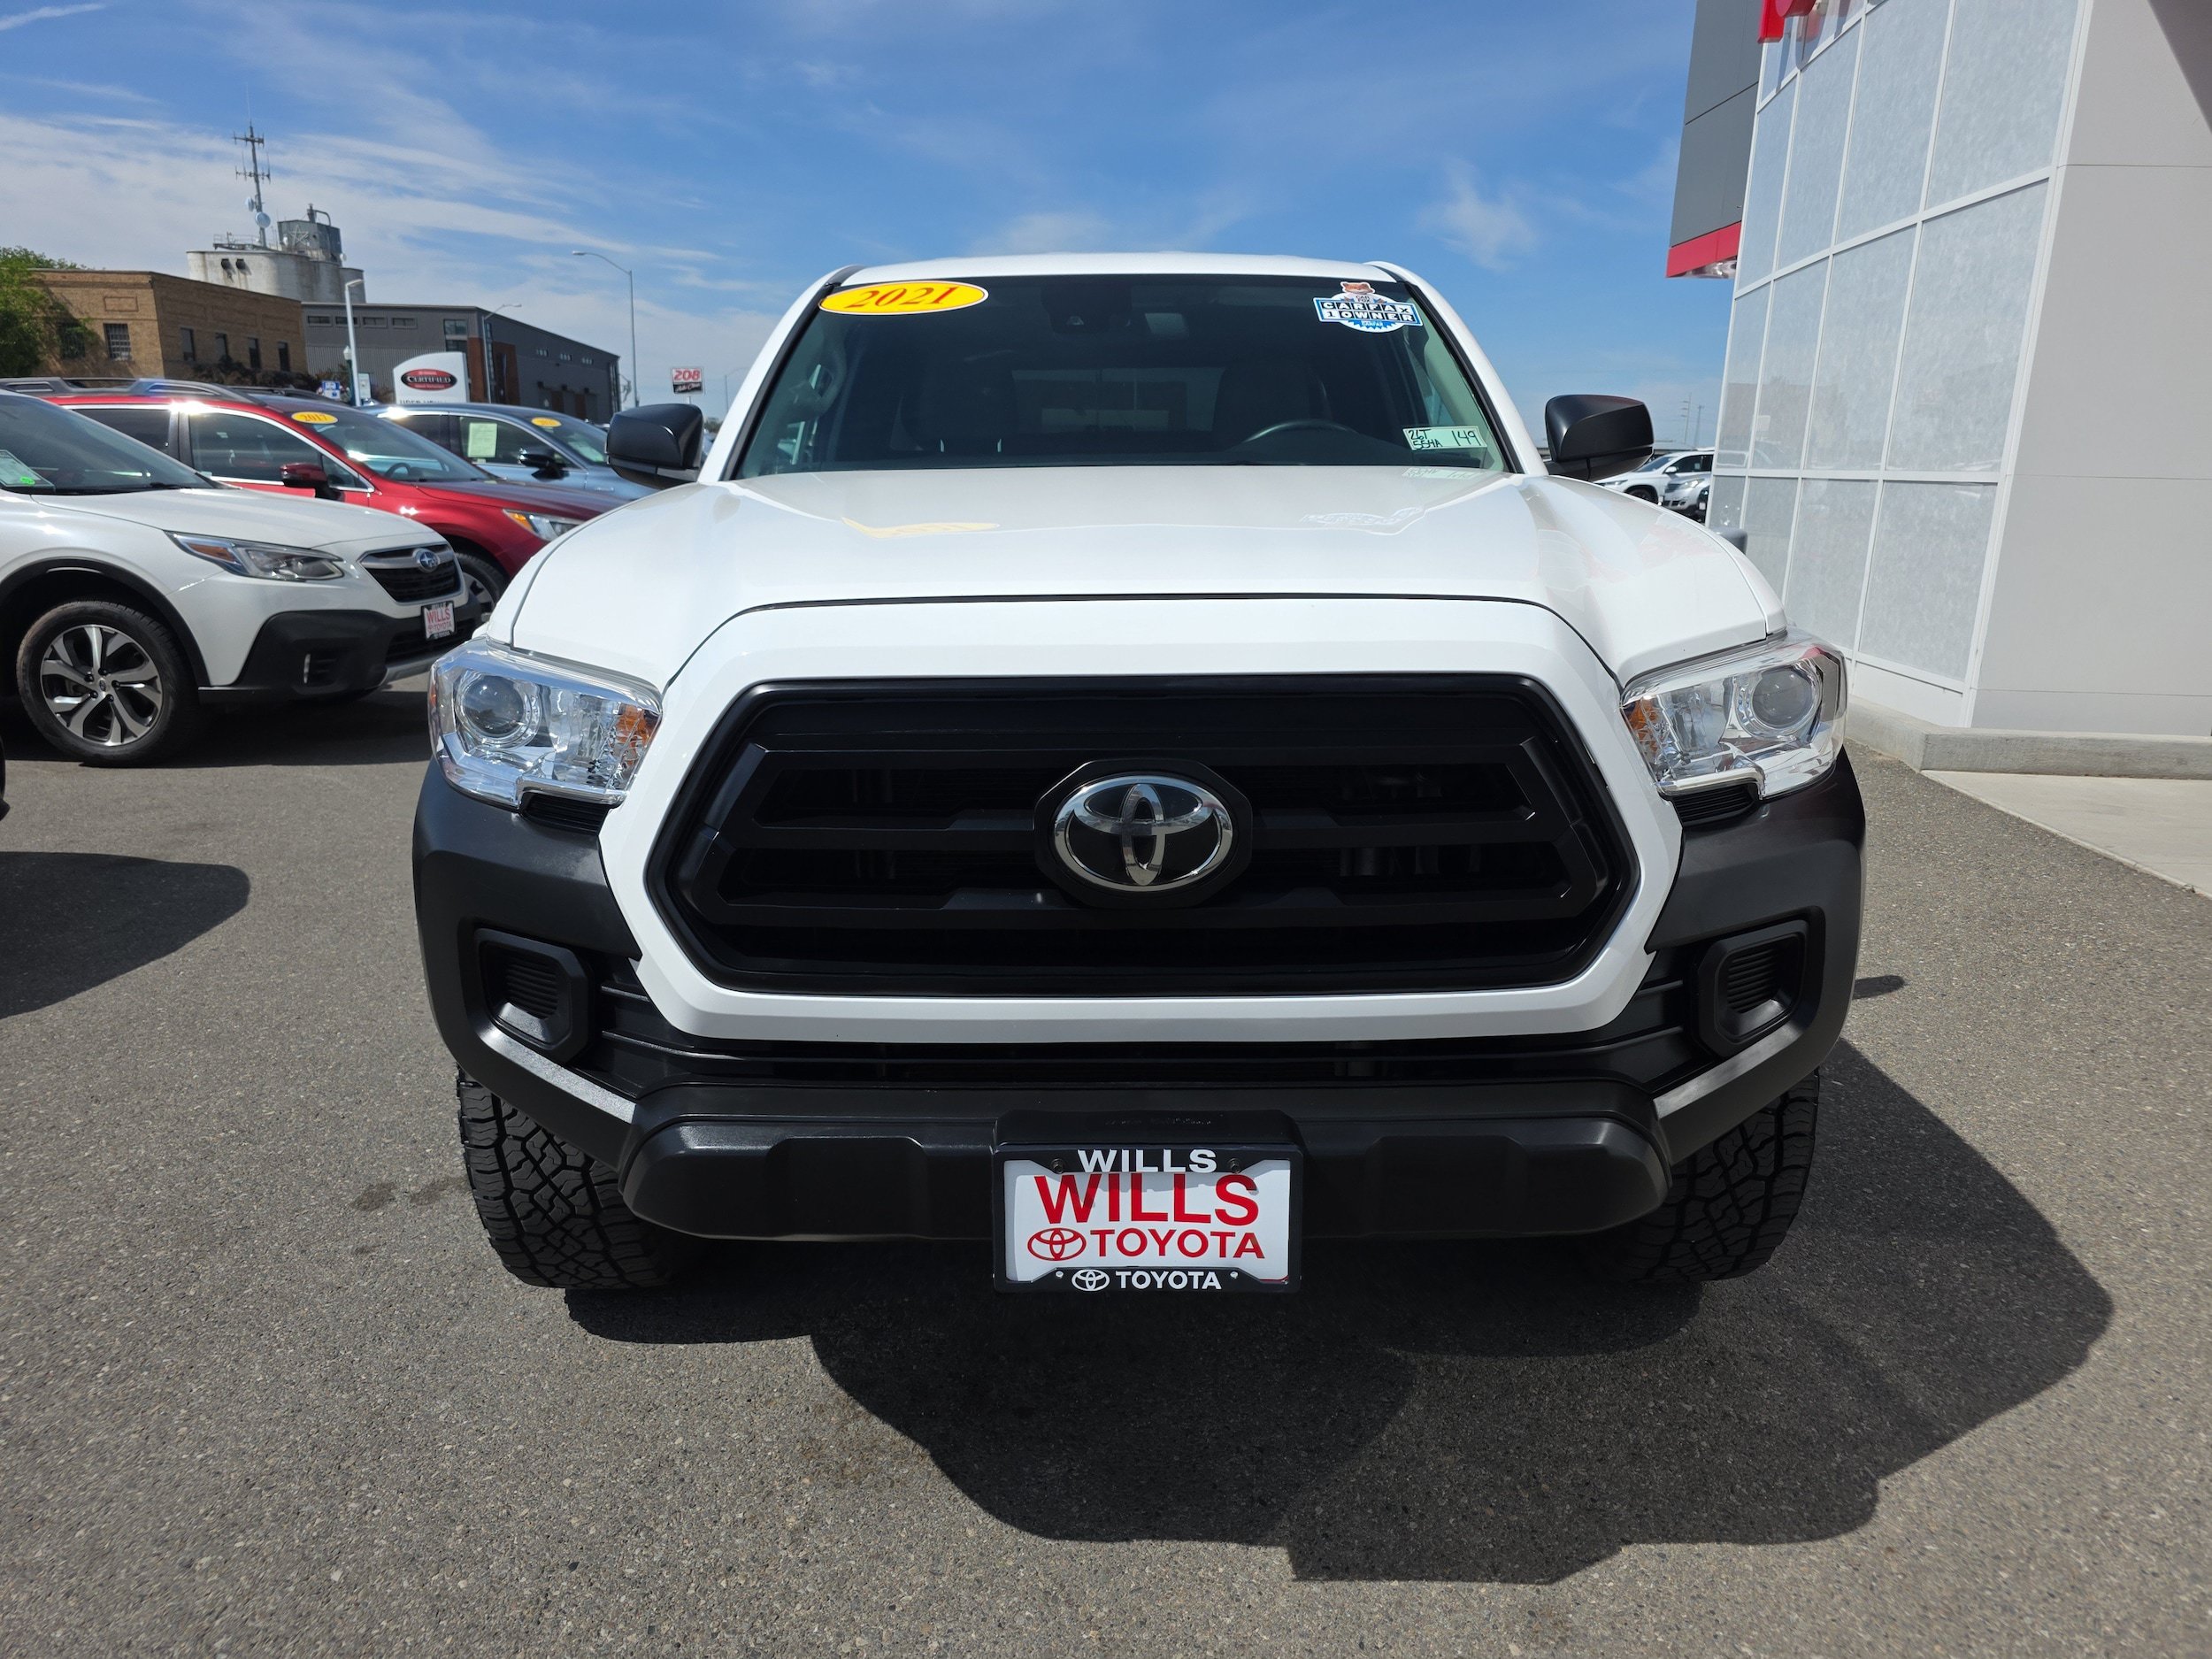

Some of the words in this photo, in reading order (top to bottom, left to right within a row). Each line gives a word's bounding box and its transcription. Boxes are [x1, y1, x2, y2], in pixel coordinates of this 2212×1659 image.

[846, 287, 958, 308] 2021
[1322, 302, 1409, 313] CARFAX
[1340, 311, 1414, 321] OWNER
[673, 369, 701, 381] 208
[1451, 429, 1482, 447] 149
[426, 608, 450, 623] WILLS
[1077, 1148, 1217, 1173] WILLS
[1033, 1173, 1260, 1226] WILLS
[1089, 1227, 1266, 1259] TOYOTA
[1115, 1270, 1223, 1290] TOYOTA
